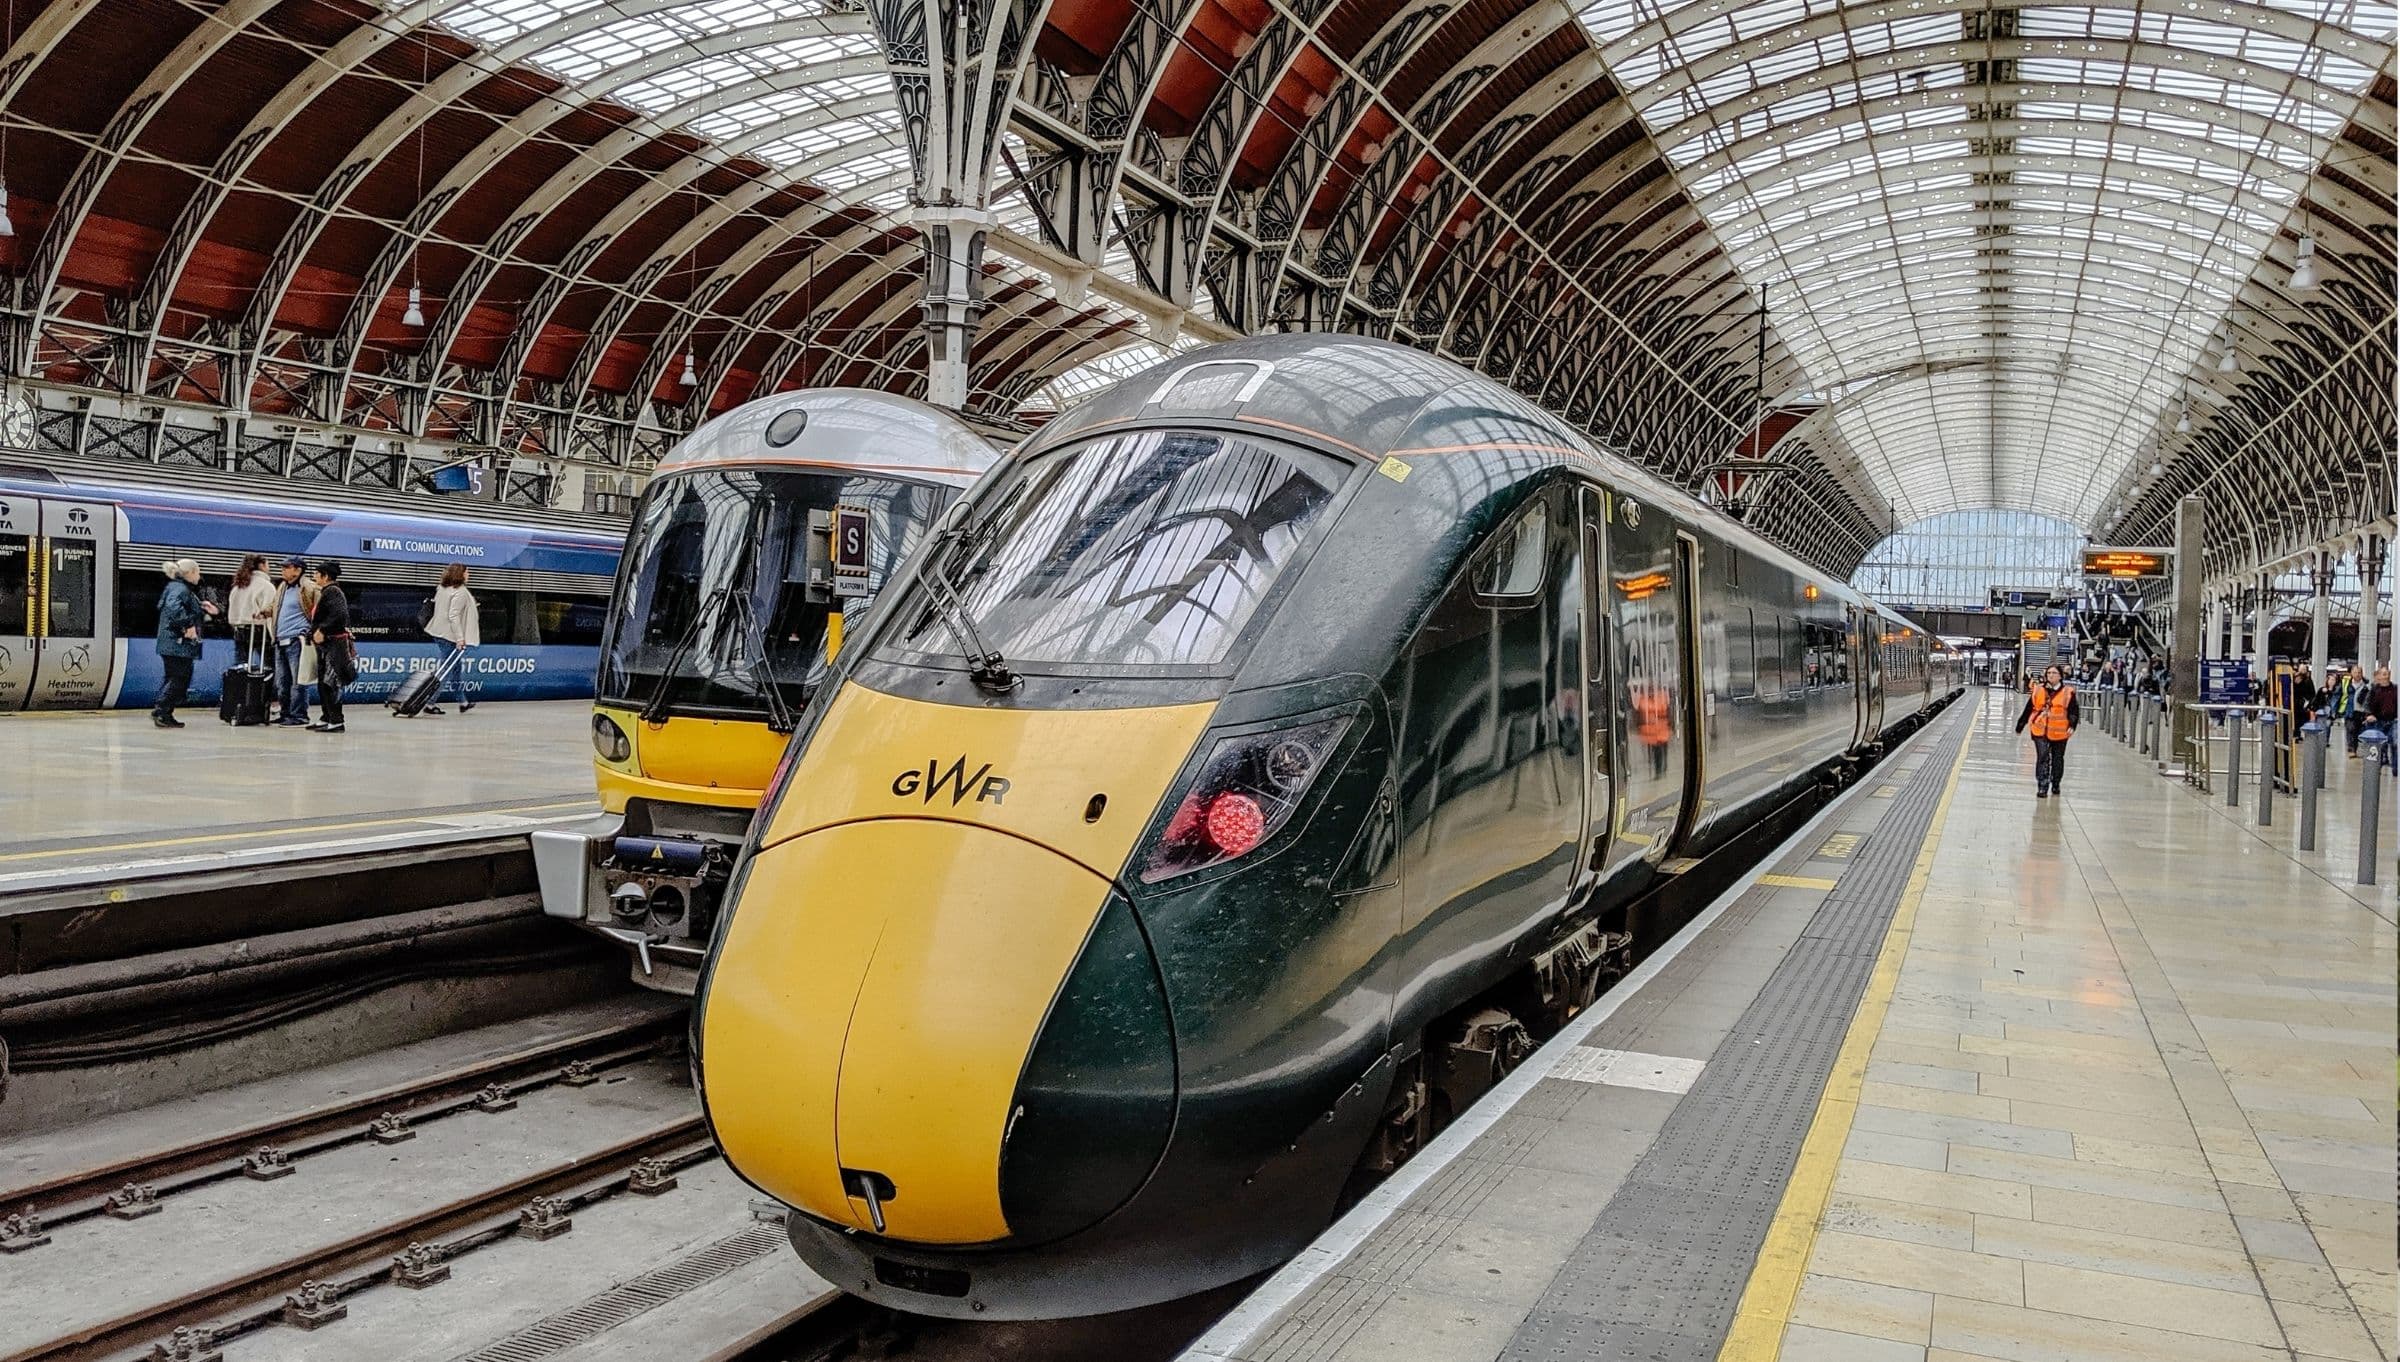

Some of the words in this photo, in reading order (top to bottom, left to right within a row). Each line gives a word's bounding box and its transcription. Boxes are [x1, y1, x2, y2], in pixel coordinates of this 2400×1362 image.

[472, 471, 483, 495] 5
[0, 520, 13, 529] TA
[65, 525, 92, 535] TATA
[374, 538, 402, 550] TATA
[405, 540, 484, 557] COMMUNICATIONS
[846, 527, 859, 555] S
[53, 548, 63, 571] 1
[64, 548, 93, 556] BUSINESS
[353, 656, 405, 674] RLD'S
[409, 656, 475, 674] BIGT
[478, 657, 535, 674] CLOUDS
[47, 679, 96, 689] Heathrow
[343, 681, 381, 693] WE'RE
[892, 752, 1011, 808] GWR
